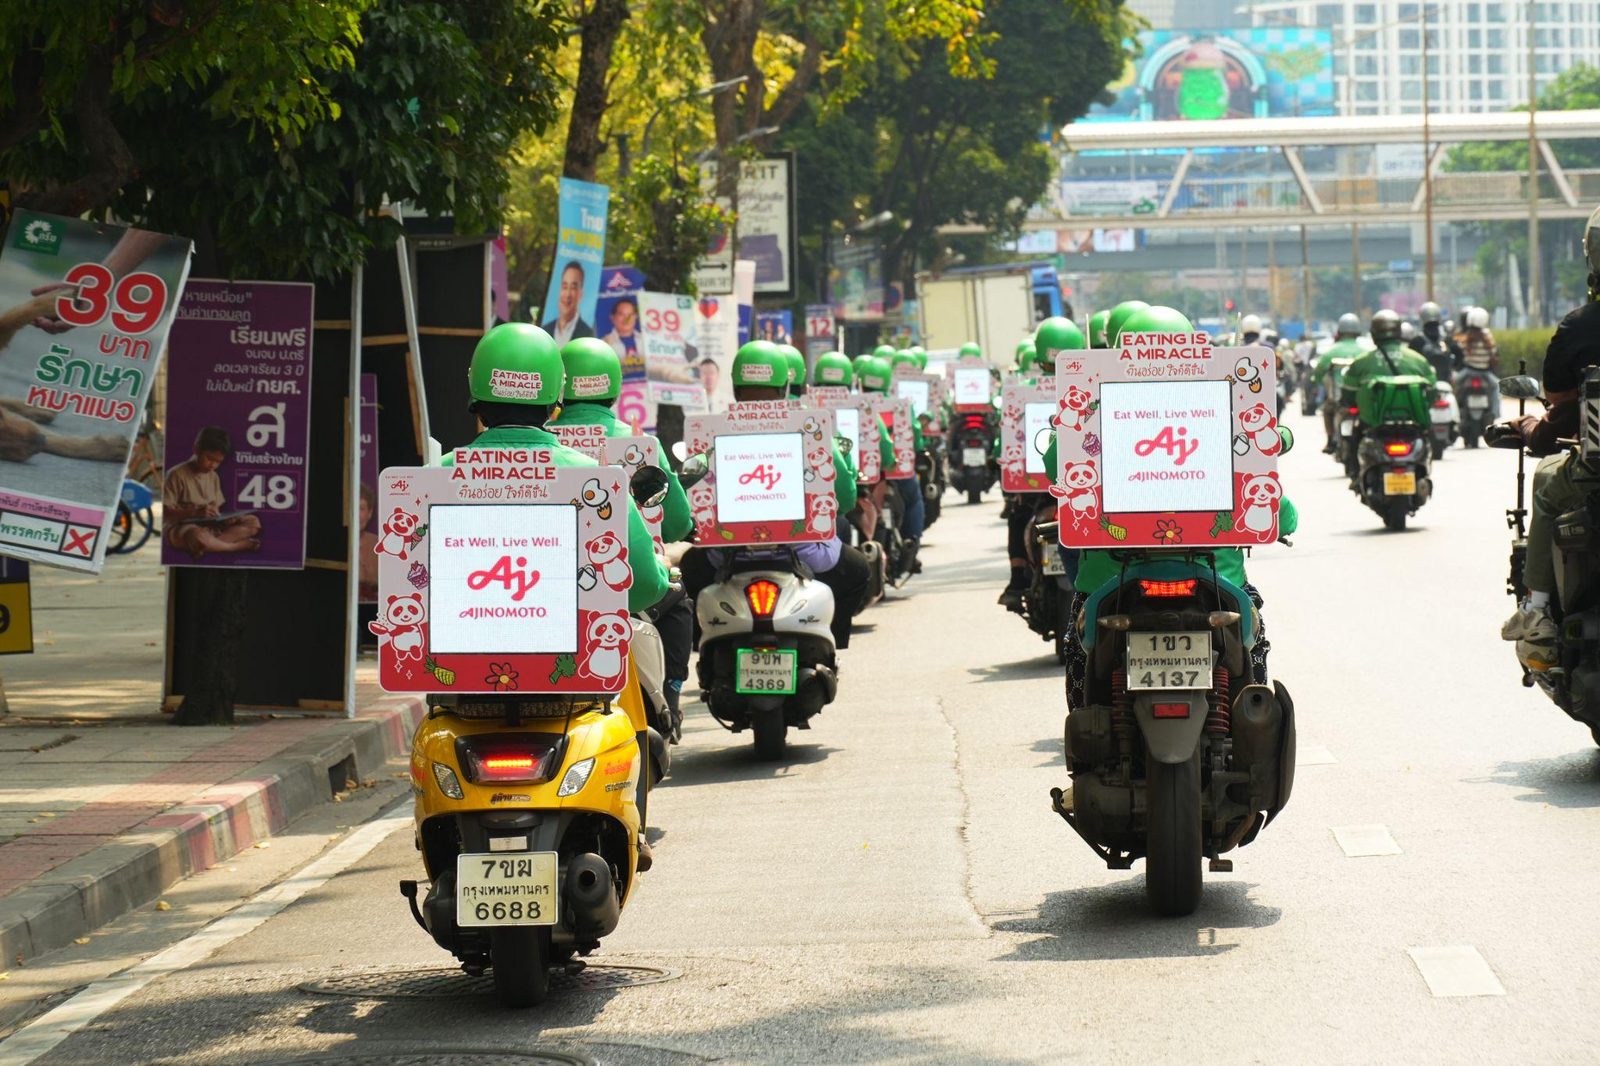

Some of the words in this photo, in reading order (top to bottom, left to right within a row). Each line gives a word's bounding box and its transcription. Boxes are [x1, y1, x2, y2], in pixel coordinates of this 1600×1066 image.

[56, 262, 168, 335] 39
[645, 308, 681, 332] 39
[809, 316, 833, 337] 12
[230, 325, 306, 347] เรียนฟรี
[1122, 333, 1187, 346] EATING
[1191, 333, 1207, 344] IS
[99, 332, 151, 361] บาท
[1119, 349, 1133, 360] A
[1137, 348, 1211, 360] MIRACLE
[35, 343, 144, 398] รักษา
[214, 362, 281, 376] ลดเวลาเรียน
[283, 365, 293, 376] 3
[295, 364, 304, 377] ปี
[492, 370, 530, 380] EATING
[530, 373, 540, 381] IS
[1126, 362, 1165, 377] กินอร่อย
[256, 379, 302, 395] กยศ.
[499, 380, 542, 389] MIRACLE
[25, 384, 136, 422] หมาแมว
[618, 390, 647, 425] 6
[728, 402, 772, 411] EATING
[774, 402, 785, 410] IS
[727, 413, 735, 421] A
[738, 411, 788, 420] MIRACLE
[1113, 410, 1131, 420] Eat
[1164, 409, 1188, 419] Live
[590, 426, 602, 436] IS
[560, 437, 606, 448] RACLE
[1134, 425, 1199, 466] Aj
[455, 450, 528, 464] EATING
[533, 450, 551, 464] IS
[452, 467, 466, 480] A
[472, 467, 556, 480] MIRACLE
[738, 464, 782, 490] Aj
[1128, 470, 1206, 483] AJINOMOTO
[237, 474, 295, 510] 48
[458, 483, 501, 499] กินอร่อย
[735, 493, 787, 503] AJINOMOTO
[0, 522, 60, 543] พรรคกรีน
[444, 537, 464, 547] Eat
[468, 537, 498, 548] Well,
[502, 537, 528, 547] Live
[532, 537, 562, 547] Well.
[467, 555, 541, 602] Aj
[459, 607, 547, 620] AJINOMOTO
[1149, 635, 1191, 651] 1ขว
[1130, 657, 1209, 669] กรุงเทพมหานคร
[745, 678, 785, 690] 4369
[1140, 671, 1199, 687] 4137
[463, 884, 550, 900] กรุงเทพมหานคร
[475, 901, 541, 920] 6688
